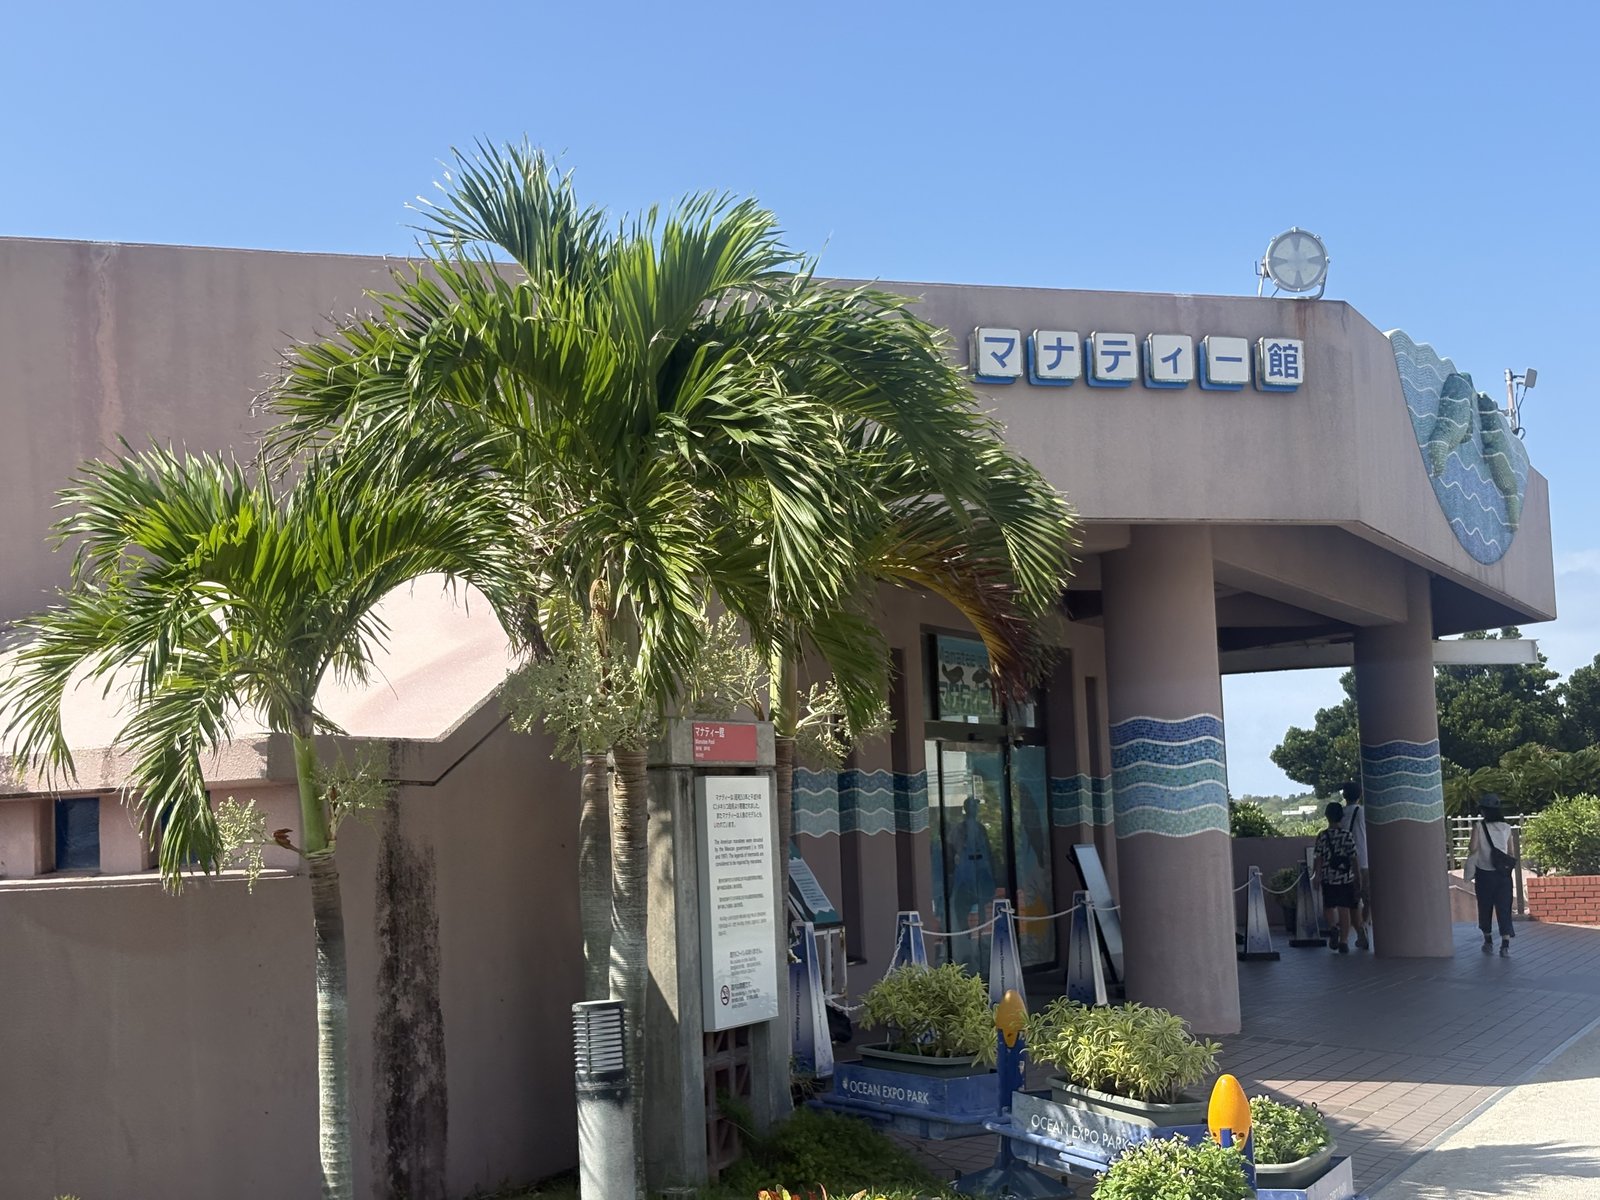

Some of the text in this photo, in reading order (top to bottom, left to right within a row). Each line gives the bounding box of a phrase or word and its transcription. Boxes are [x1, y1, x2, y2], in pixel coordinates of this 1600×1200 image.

[983, 336, 1300, 380] マナティー館
[849, 1080, 929, 1105] OCEAN EXPO PARK
[1031, 1114, 1131, 1151] OCEAN EXPO PARK
